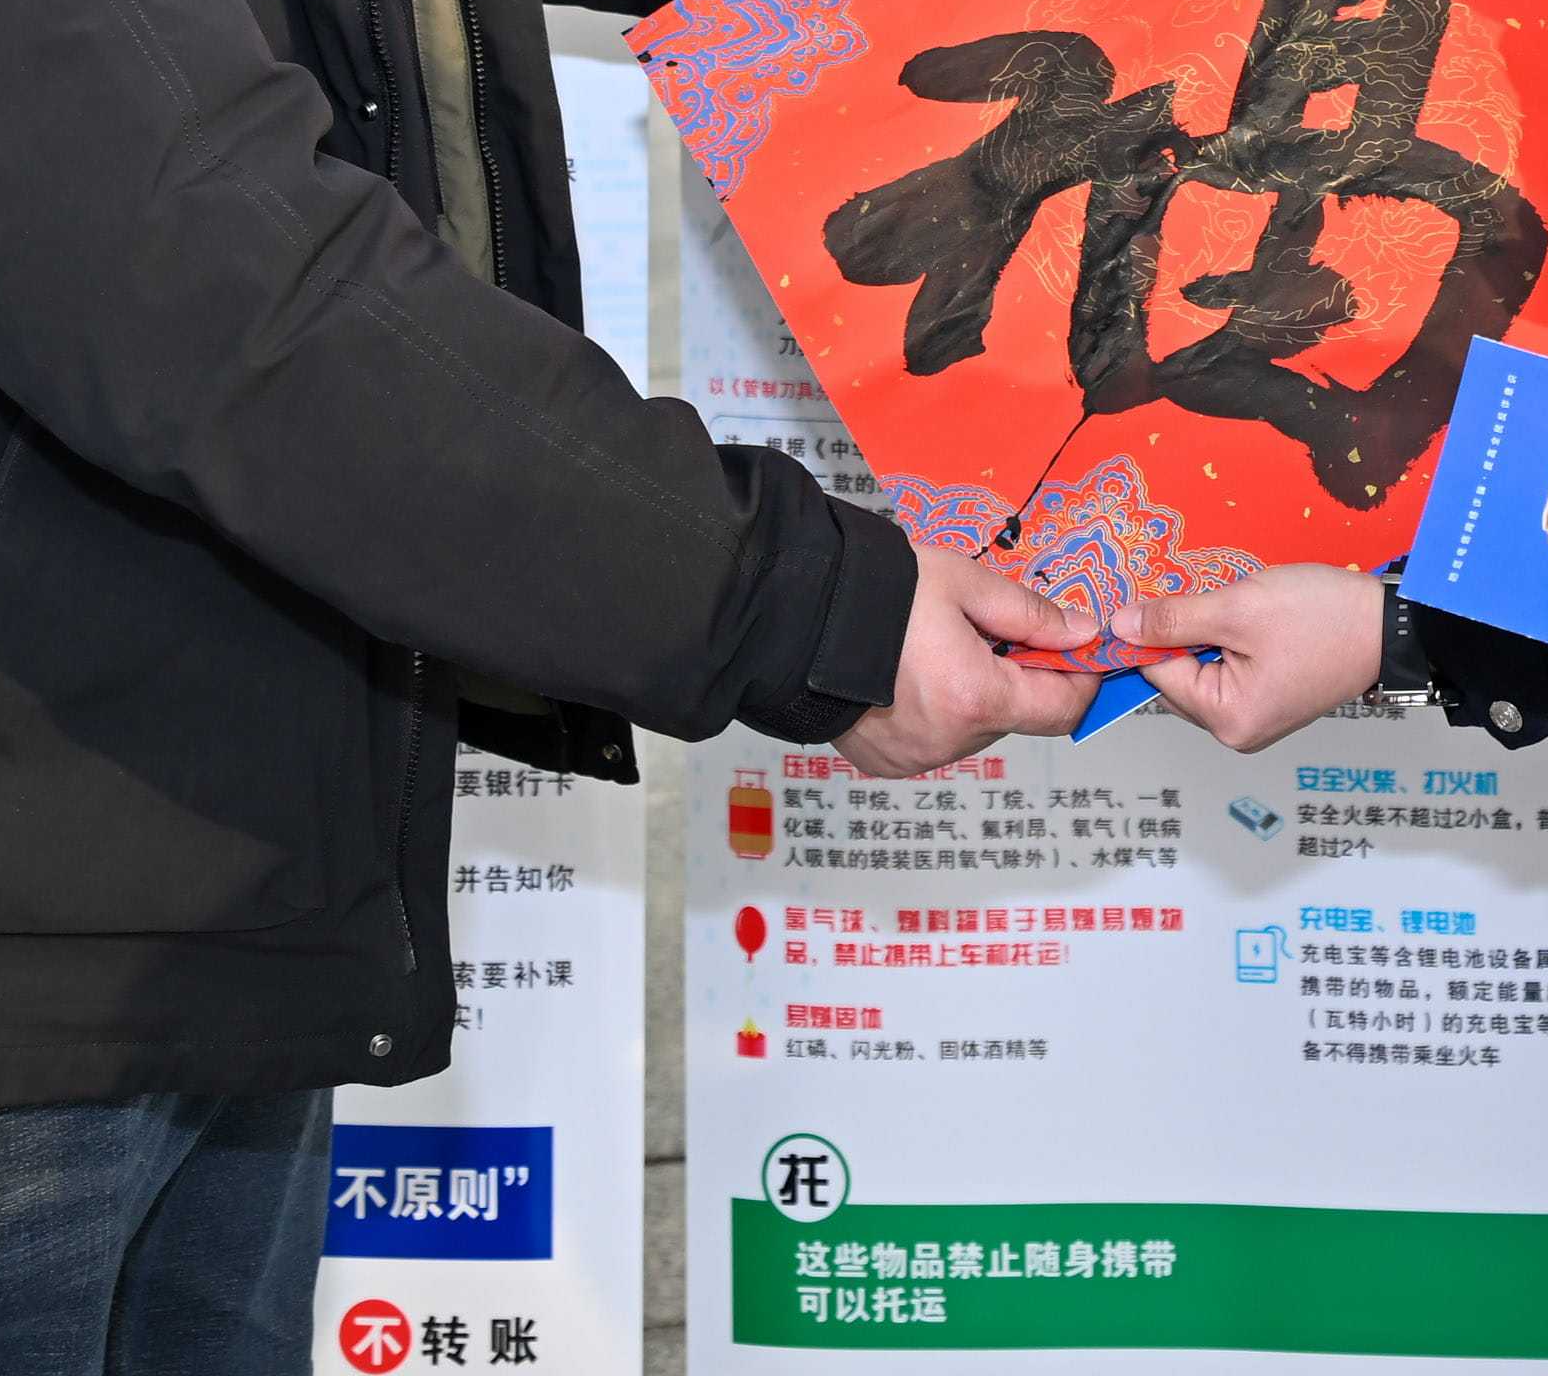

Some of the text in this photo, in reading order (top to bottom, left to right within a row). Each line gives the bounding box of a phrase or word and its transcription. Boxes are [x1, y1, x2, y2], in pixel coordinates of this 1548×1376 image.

[455, 768, 575, 798] 要银行卡
[1296, 766, 1499, 797] 安全火柴、打火机
[1297, 836, 1375, 860] 超过2个
[453, 864, 575, 894] 并告知你
[1299, 905, 1477, 936] 充电宝、锂电池
[452, 960, 575, 989] 索要补课
[785, 1003, 884, 1030] 易燃固体
[785, 1038, 1049, 1062] 红磷、闪光粉、固体酒精等
[1301, 1041, 1502, 1068] 备不得携带乘坐火车
[778, 1153, 830, 1208] 托
[794, 1238, 1177, 1280] 这些物品禁止随身携带
[796, 1286, 949, 1325] 可以托运
[352, 1316, 403, 1367] 不
